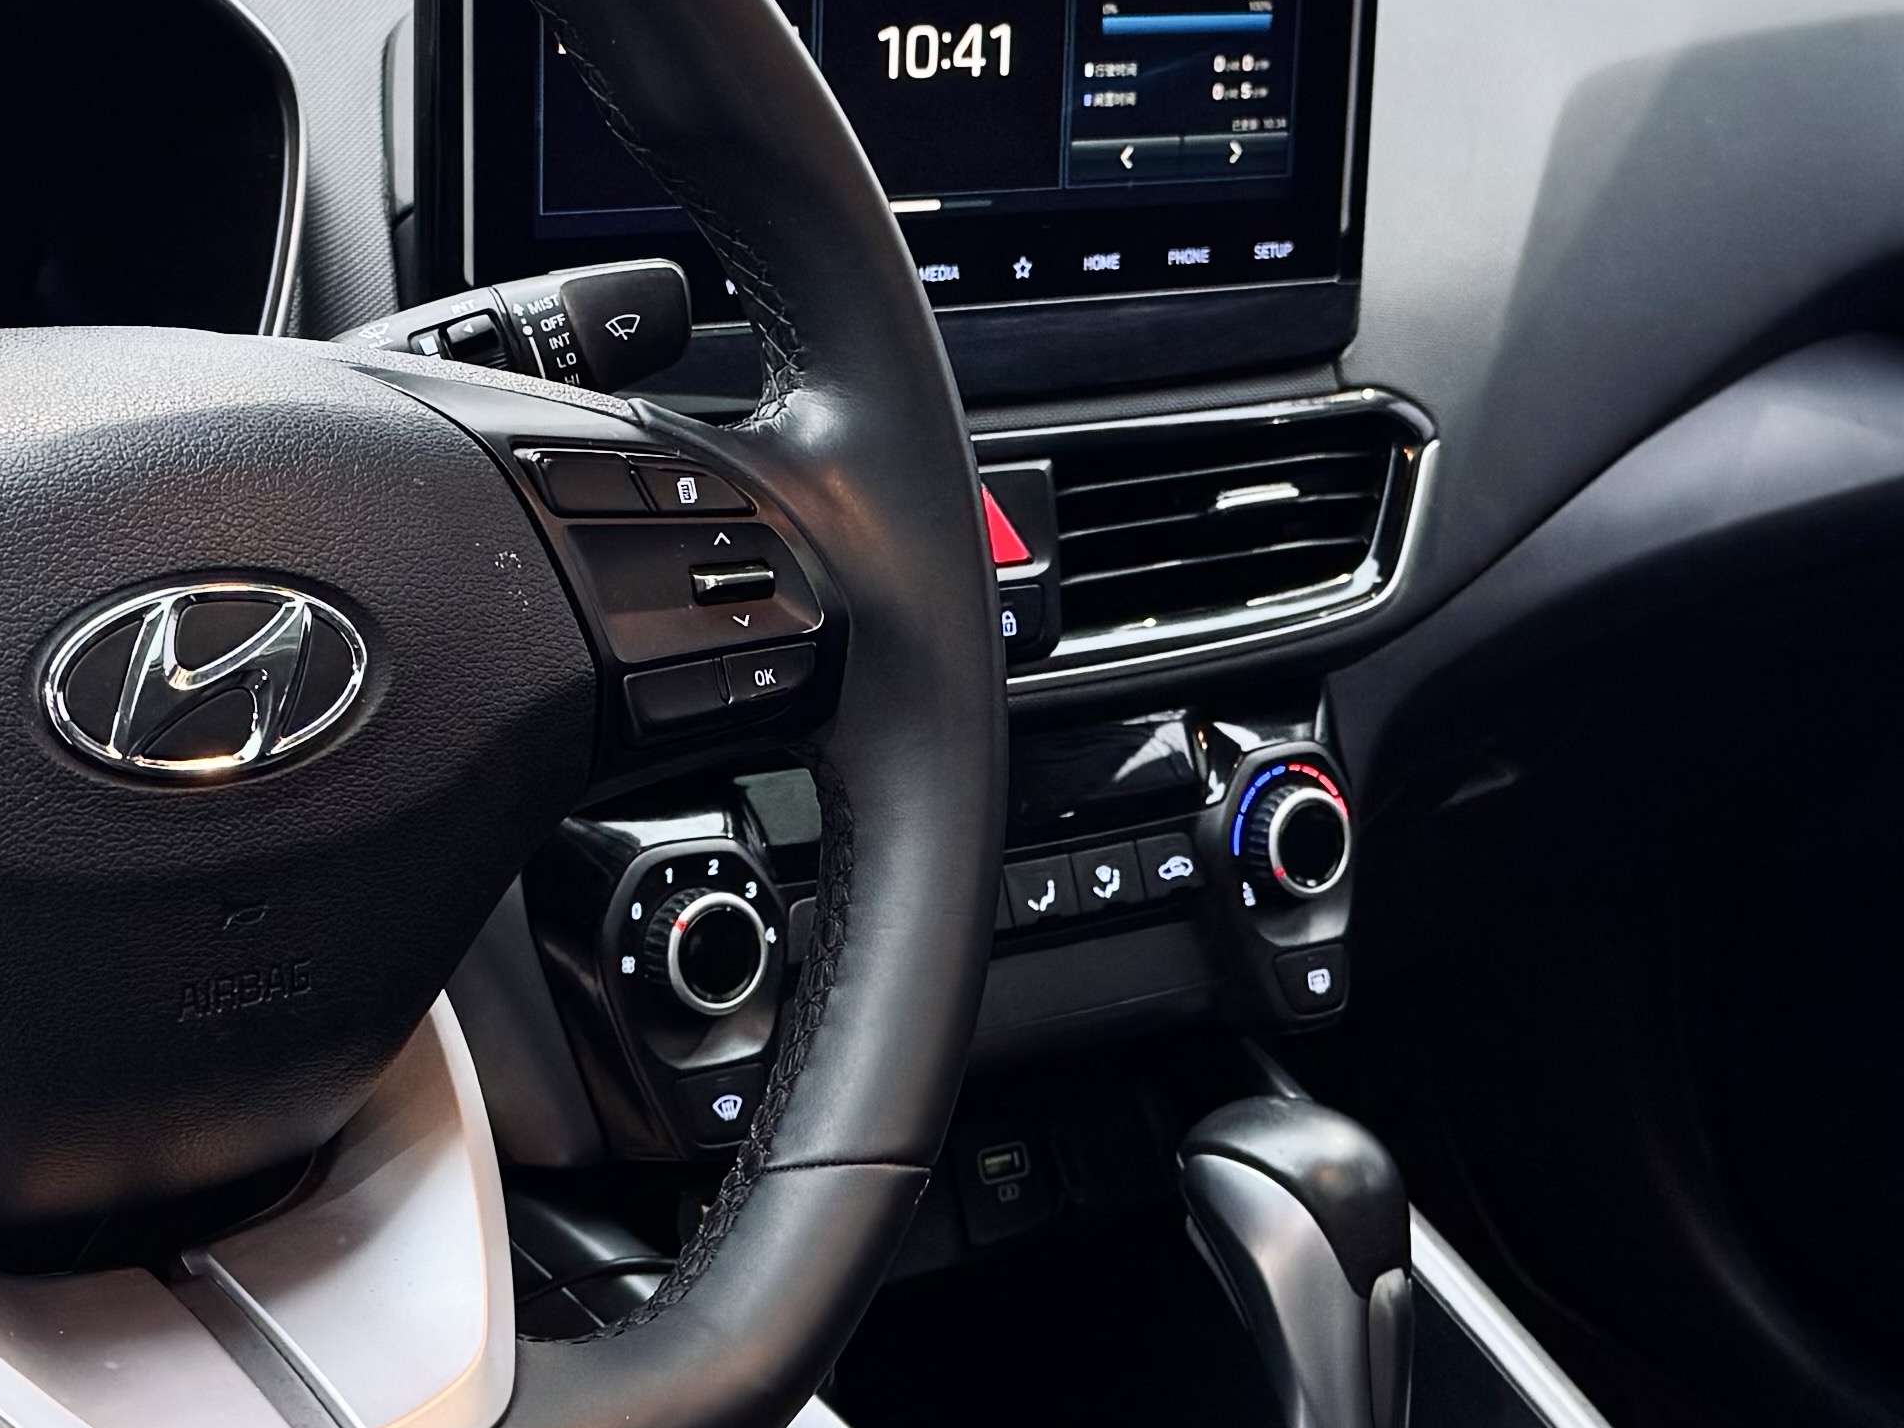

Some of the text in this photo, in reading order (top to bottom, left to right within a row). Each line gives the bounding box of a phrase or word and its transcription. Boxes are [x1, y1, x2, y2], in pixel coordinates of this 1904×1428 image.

[878, 23, 1013, 82] 10:41
[1168, 246, 1211, 265] PHONE
[1254, 240, 1295, 260] SETUP
[1084, 252, 1121, 271] HOME
[527, 294, 562, 317] MIST
[540, 314, 566, 332] OFF
[549, 332, 572, 351] INT
[557, 352, 577, 369] LO
[754, 667, 776, 687] OK
[664, 867, 673, 884] 1
[707, 858, 719, 876] 2
[745, 881, 757, 899] 3
[631, 902, 642, 920] 0
[764, 926, 777, 944] 4
[178, 961, 313, 1023] AIRBAG
